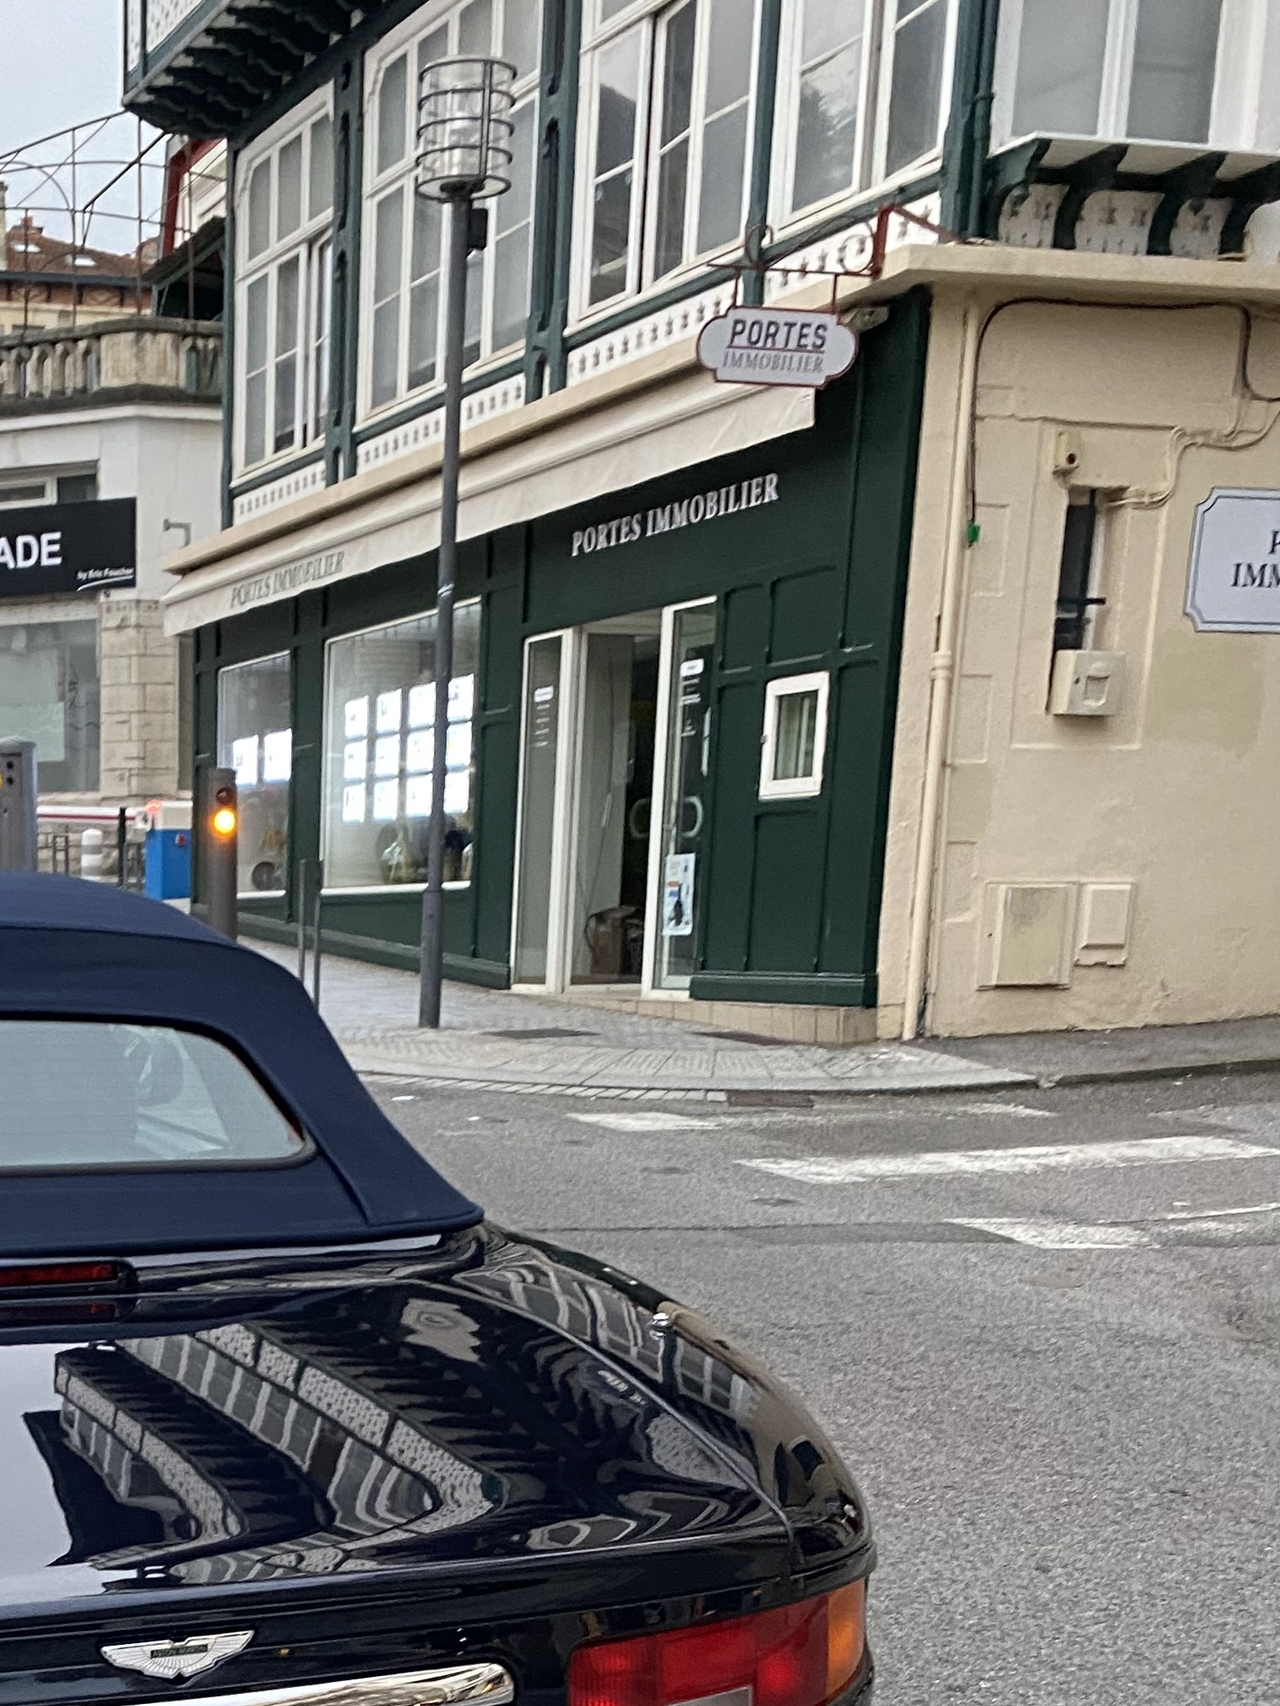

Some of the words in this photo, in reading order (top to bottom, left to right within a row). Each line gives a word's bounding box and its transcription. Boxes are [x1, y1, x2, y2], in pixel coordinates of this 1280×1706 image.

[729, 318, 828, 350] PORTES
[722, 351, 824, 373] IMMOBILIER
[571, 513, 642, 557] PORTES
[645, 472, 779, 537] IMMOBILIER
[230, 576, 272, 608] PORTES
[271, 551, 345, 594] IMMOBILIER
